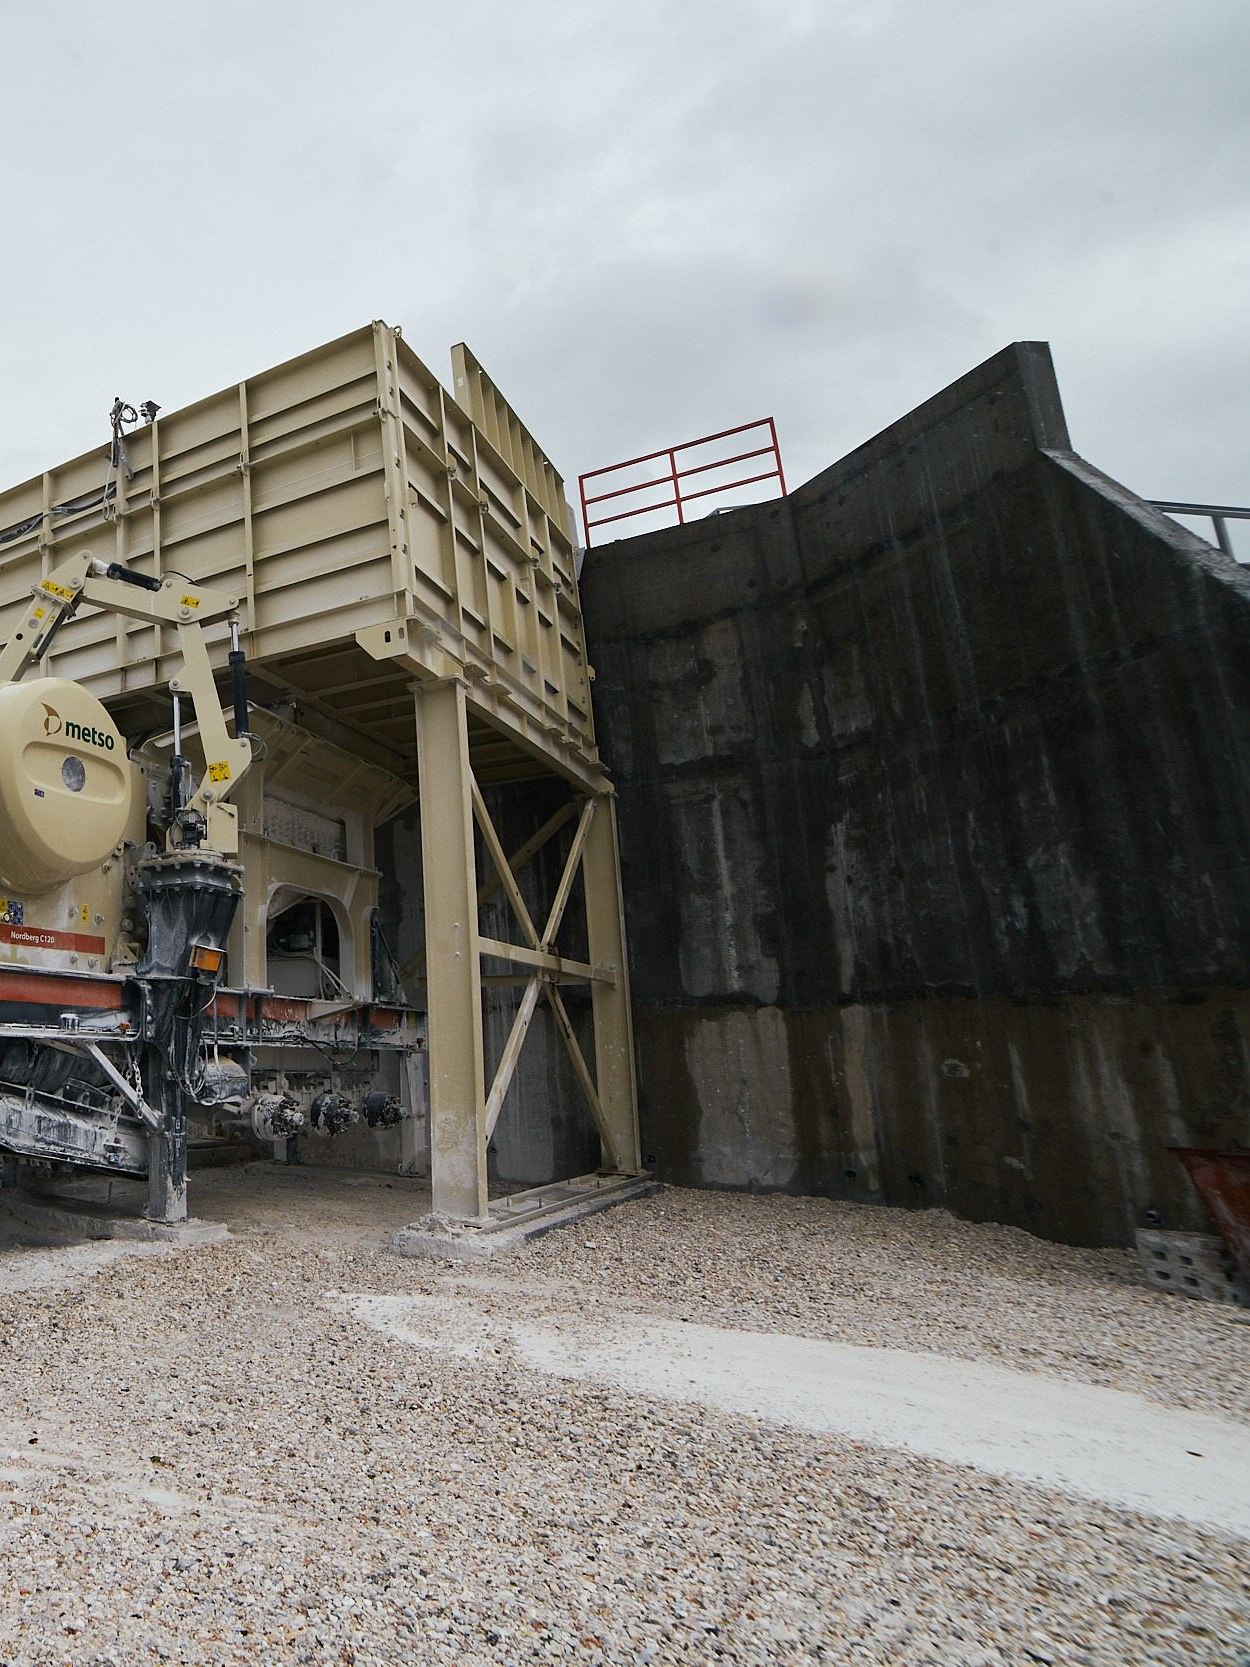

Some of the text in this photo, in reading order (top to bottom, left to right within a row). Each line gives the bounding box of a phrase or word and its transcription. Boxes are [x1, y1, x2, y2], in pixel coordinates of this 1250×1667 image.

[65, 720, 115, 751] metso
[10, 931, 55, 944] Nordberg C120
